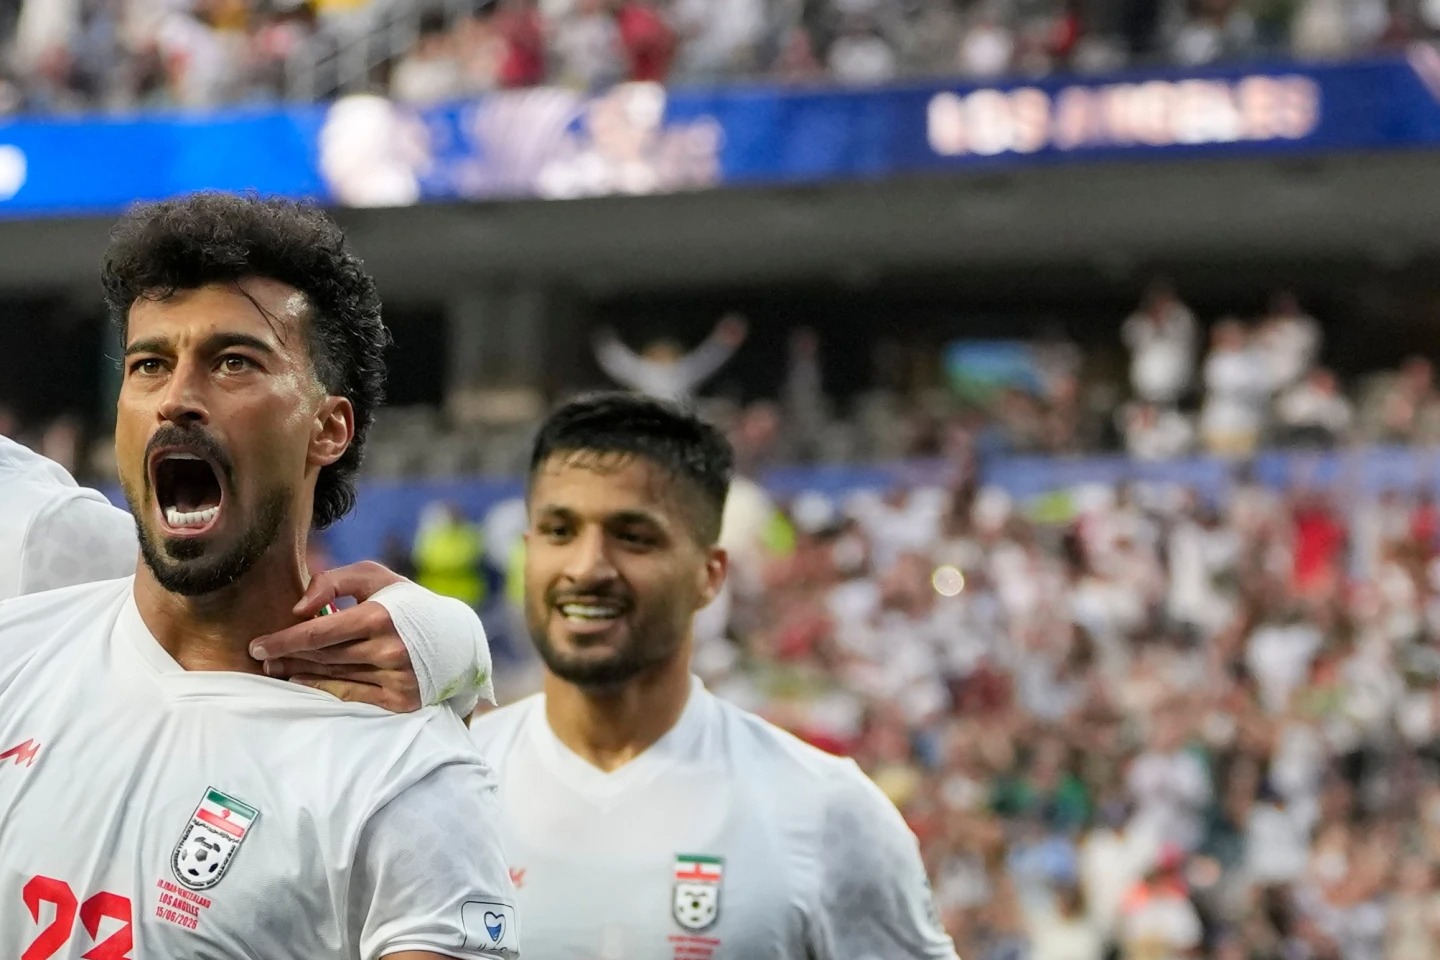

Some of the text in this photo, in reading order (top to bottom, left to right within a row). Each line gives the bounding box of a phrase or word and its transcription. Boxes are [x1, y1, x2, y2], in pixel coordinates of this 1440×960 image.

[159, 892, 199, 917] LOS ANGELES
[156, 906, 198, 930] 15/06/2026
